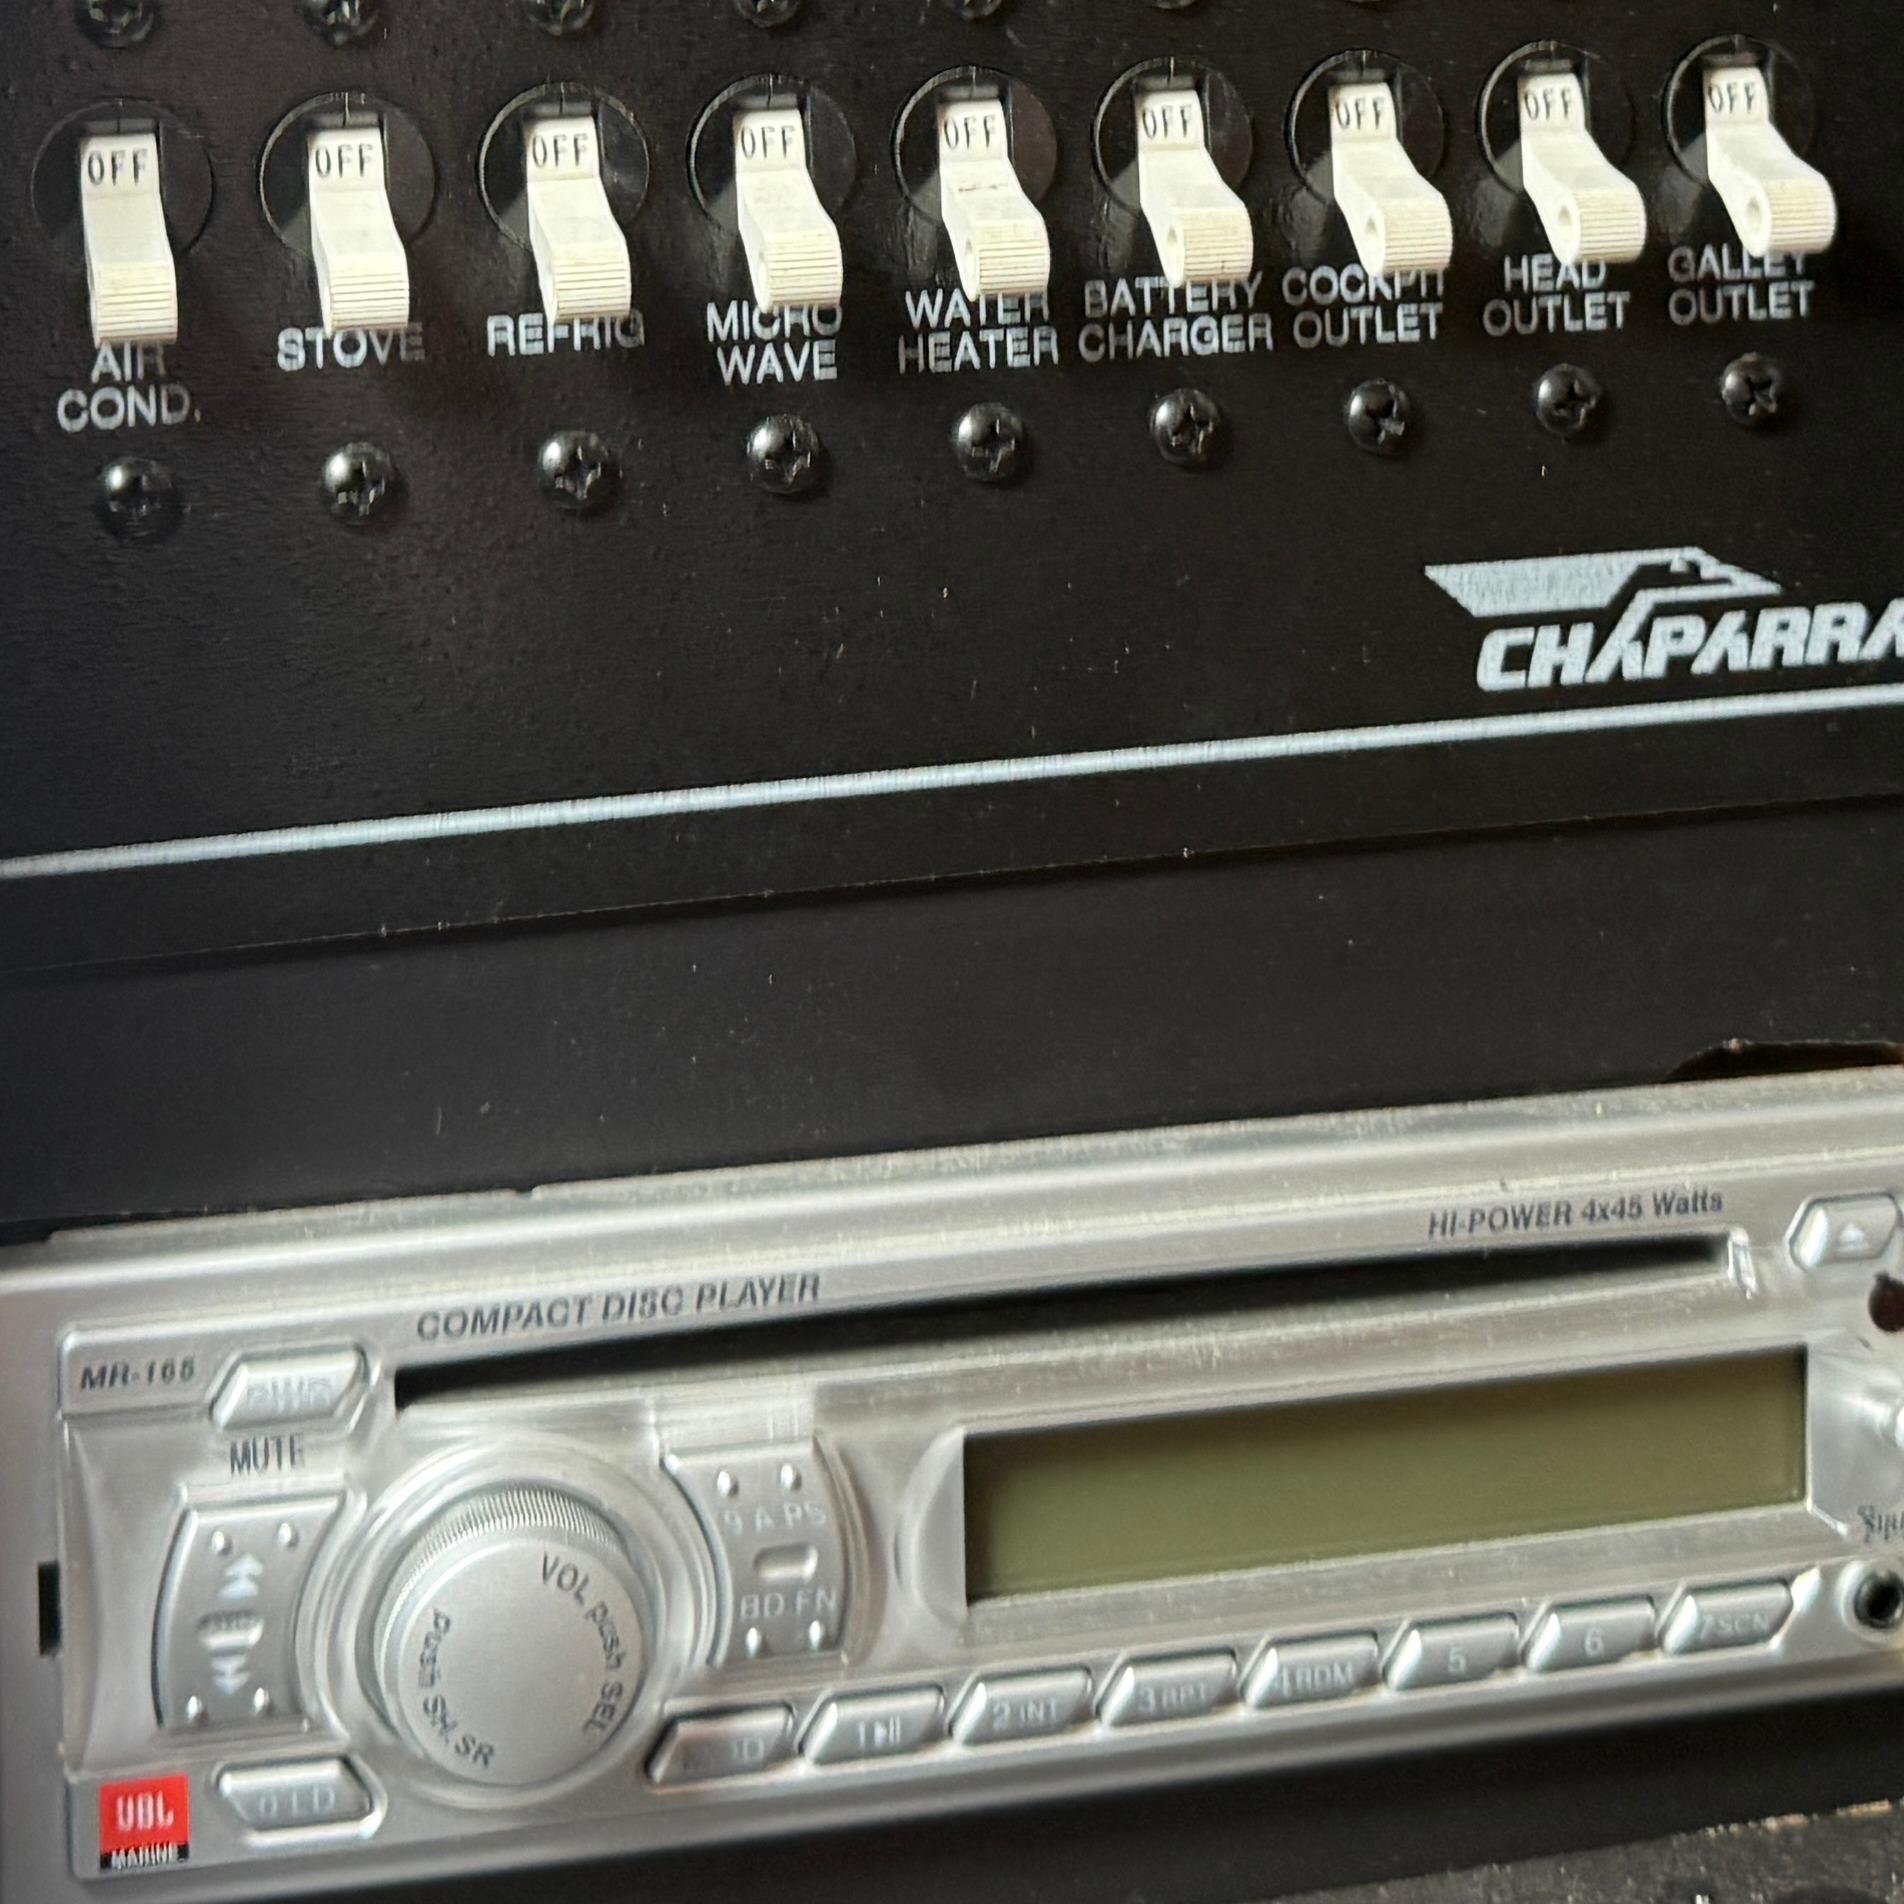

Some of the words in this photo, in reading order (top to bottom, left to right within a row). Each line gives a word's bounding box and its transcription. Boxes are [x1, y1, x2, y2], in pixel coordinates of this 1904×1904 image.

[1335, 96, 1386, 130] OFF
[1524, 88, 1573, 121] OFF
[1710, 82, 1756, 114] OFF
[741, 125, 796, 160] OFF
[944, 113, 996, 152] OFF
[1142, 104, 1192, 140] OFF
[87, 149, 148, 186] OFF
[315, 144, 374, 178] OFF
[531, 133, 589, 168] OFF
[1505, 255, 1606, 293] HEAD
[1668, 245, 1808, 282] GALLEY
[1085, 271, 1264, 319] BATTERY
[1282, 263, 1444, 308] COCKPIT
[1669, 282, 1814, 326] OUTLET
[707, 301, 843, 342] MICRO
[905, 288, 1049, 329] WATER
[1295, 302, 1443, 349] OUTLET
[1483, 291, 1630, 337] OUTLET
[277, 323, 425, 371] STOVE
[899, 326, 1058, 374] HEATER
[1078, 313, 1274, 363] CHARGER
[91, 342, 166, 383] AIR
[717, 340, 837, 386] WAVE
[57, 384, 200, 432] COND.
[1429, 1200, 1572, 1239] HI-POWER
[1581, 1196, 1643, 1224] 4x45
[1653, 1190, 1723, 1217] Watts
[417, 1295, 593, 1341] COMPACT
[602, 1284, 685, 1322] DISC
[696, 1272, 821, 1313] PLAYER
[230, 1433, 305, 1475] MUTE
[542, 1551, 589, 1606] VOL
[582, 1681, 623, 1733] SEL
[1448, 1647, 1467, 1674] 5
[1585, 1628, 1604, 1656] 6
[116, 1790, 174, 1832] JBL
